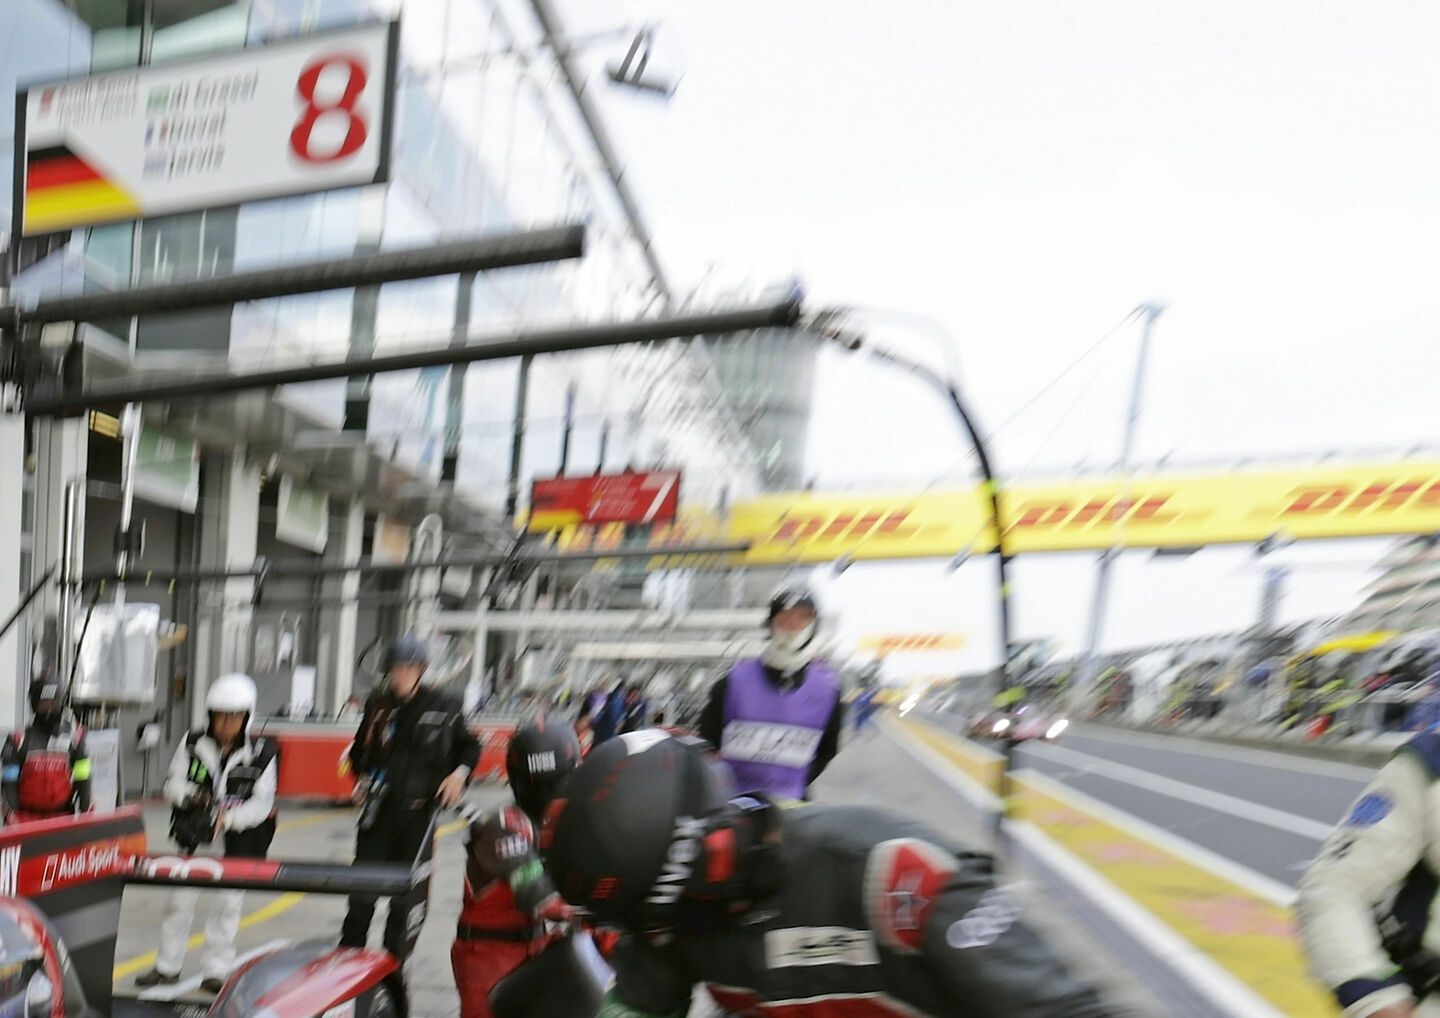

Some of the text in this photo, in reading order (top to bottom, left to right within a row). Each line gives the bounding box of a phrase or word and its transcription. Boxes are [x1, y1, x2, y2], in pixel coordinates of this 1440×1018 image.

[291, 54, 367, 163] 8
[0, 845, 22, 899] HY
[58, 843, 120, 880] Audi Sport
